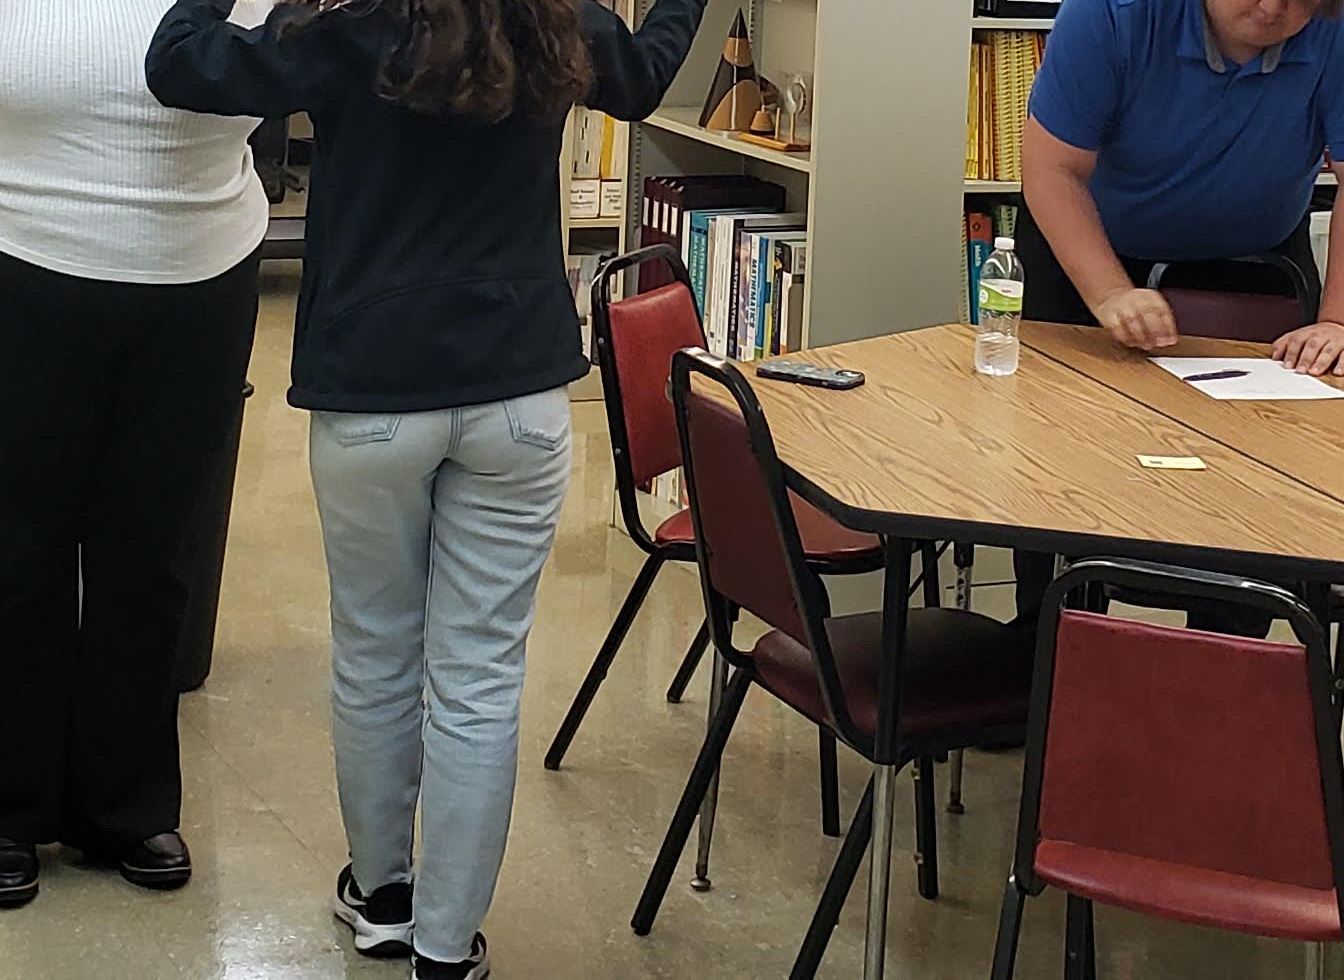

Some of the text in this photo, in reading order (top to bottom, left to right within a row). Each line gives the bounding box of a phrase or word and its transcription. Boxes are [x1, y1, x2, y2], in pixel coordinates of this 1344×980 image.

[974, 244, 982, 267] Math
[730, 260, 739, 333] MATHEMATICS
[749, 258, 759, 329] MATHEMATICS
